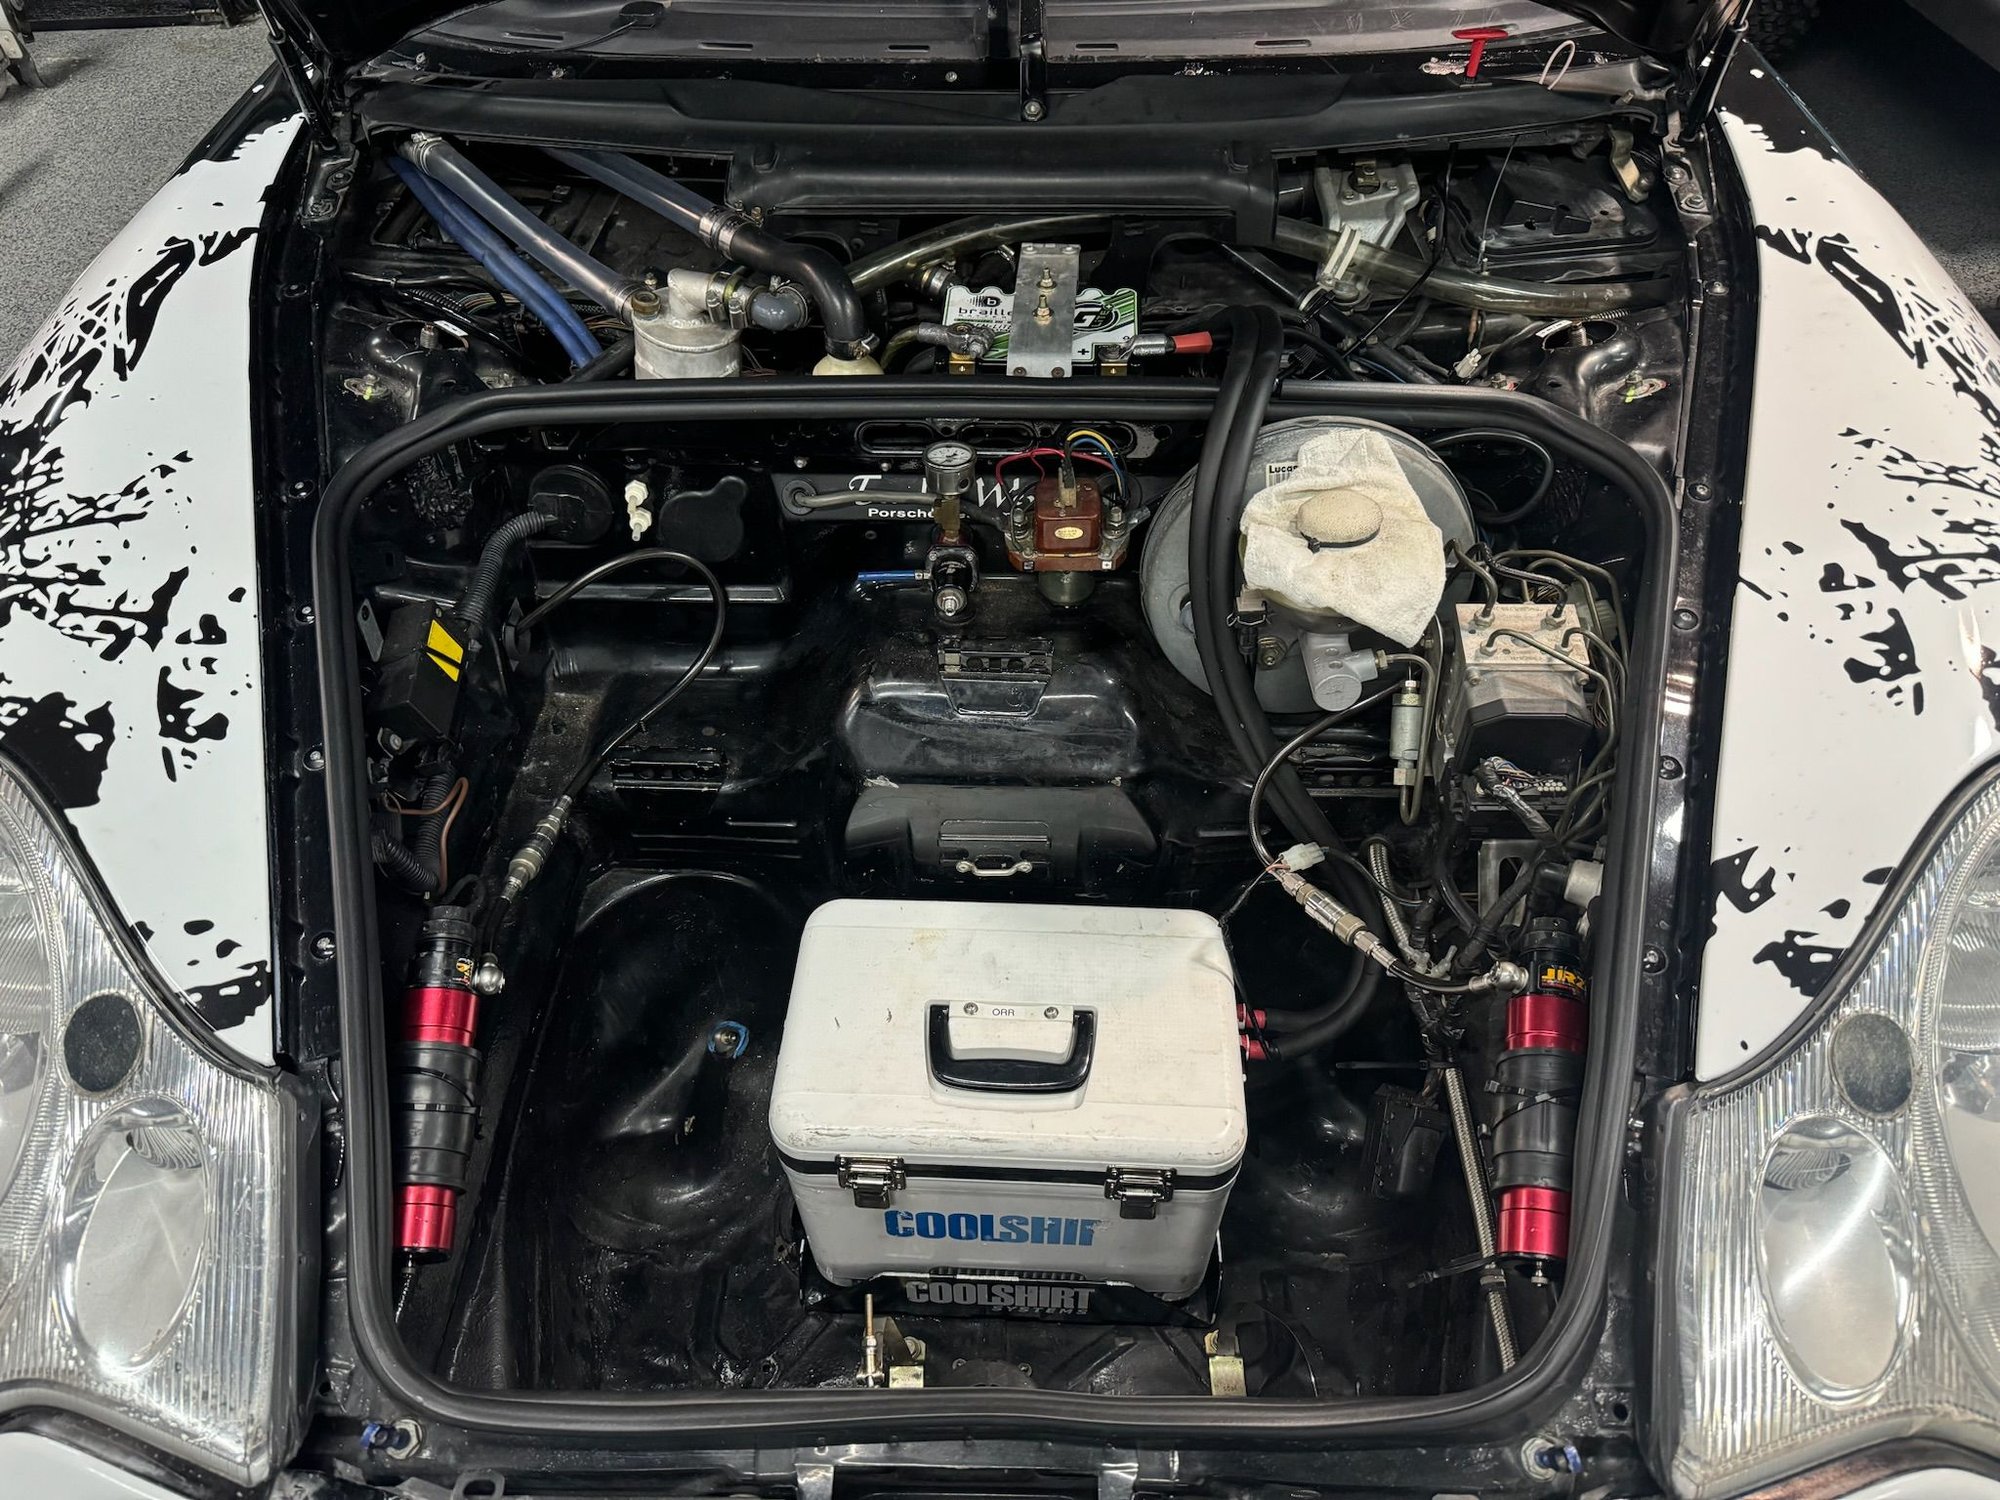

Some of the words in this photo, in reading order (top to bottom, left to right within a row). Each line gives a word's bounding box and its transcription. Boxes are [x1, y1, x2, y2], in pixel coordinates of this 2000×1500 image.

[992, 1008, 1015, 1016] ORR
[905, 1281, 1096, 1309] COOLSHIRT
[991, 1305, 1089, 1315] SYSTEMS
